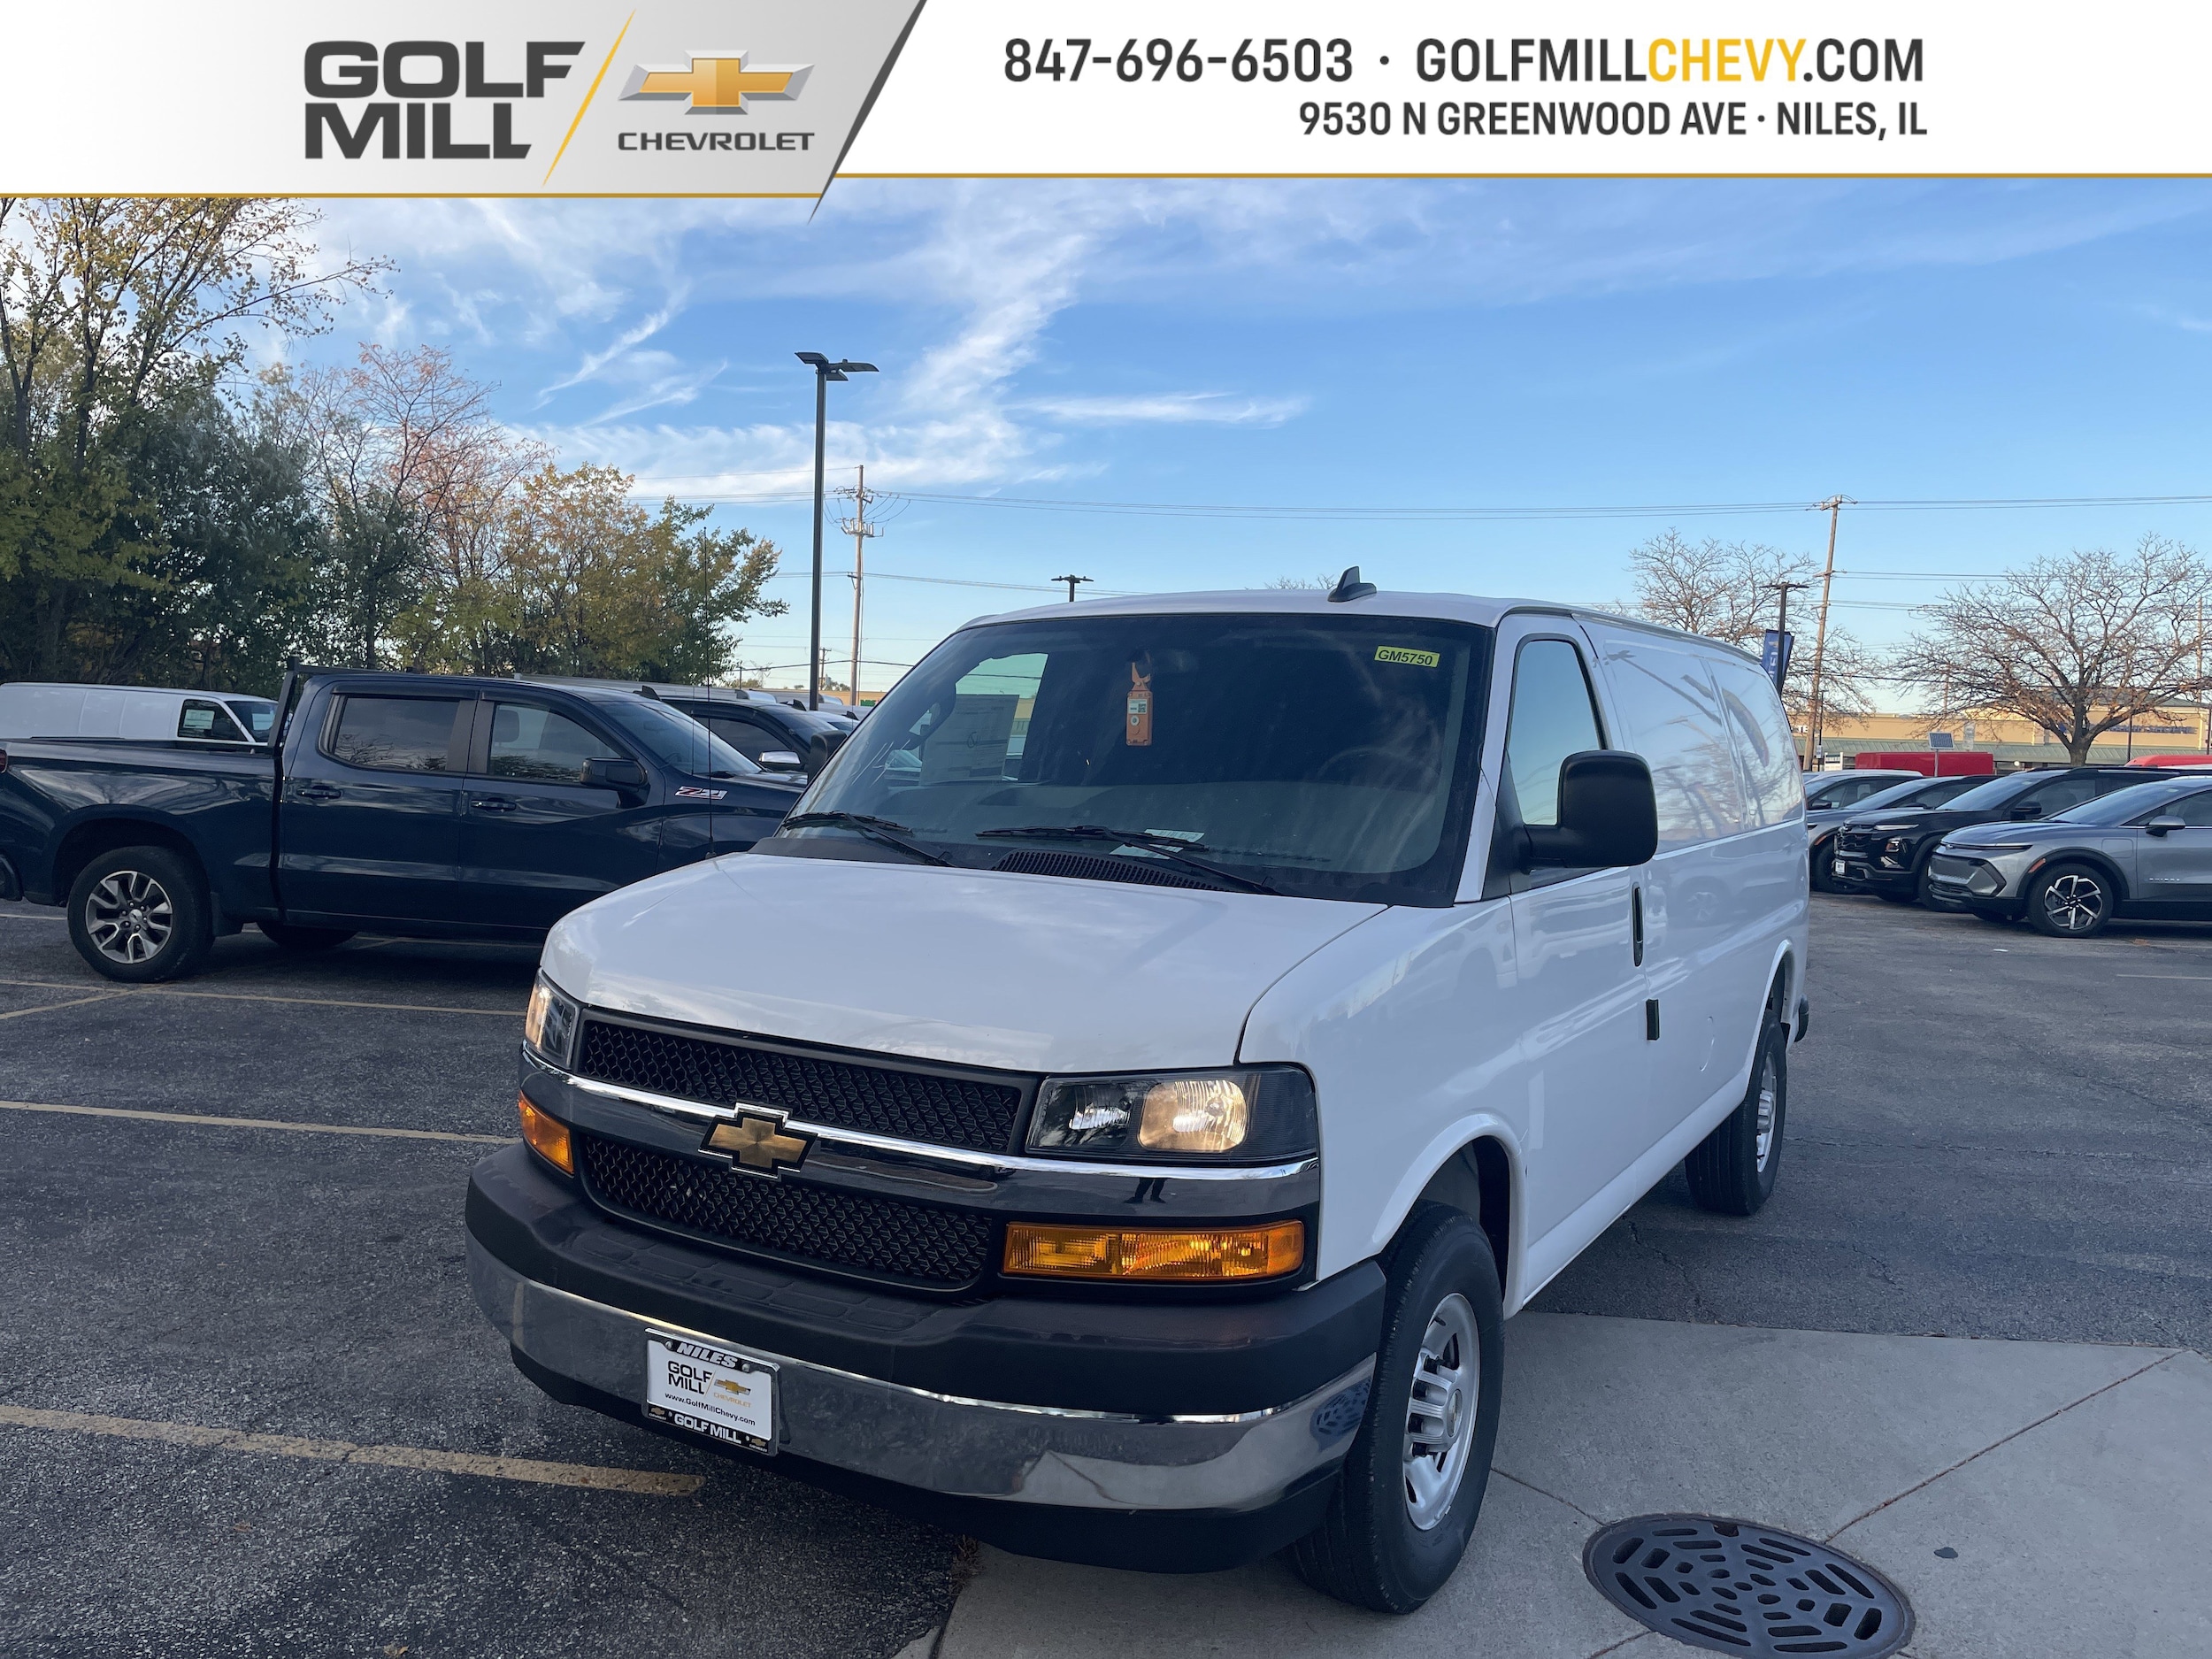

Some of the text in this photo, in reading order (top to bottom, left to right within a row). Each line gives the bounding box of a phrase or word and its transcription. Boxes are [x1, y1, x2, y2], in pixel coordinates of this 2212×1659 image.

[1379, 649, 1432, 665] GM5750
[675, 787, 728, 800] Z71
[677, 1342, 738, 1368] NILES
[668, 1361, 712, 1383] GOLF
[668, 1372, 705, 1395] MILL
[665, 1393, 756, 1426] www.GolfMillChevy.com
[674, 1413, 709, 1432] GOLF
[710, 1425, 741, 1444] MILL
